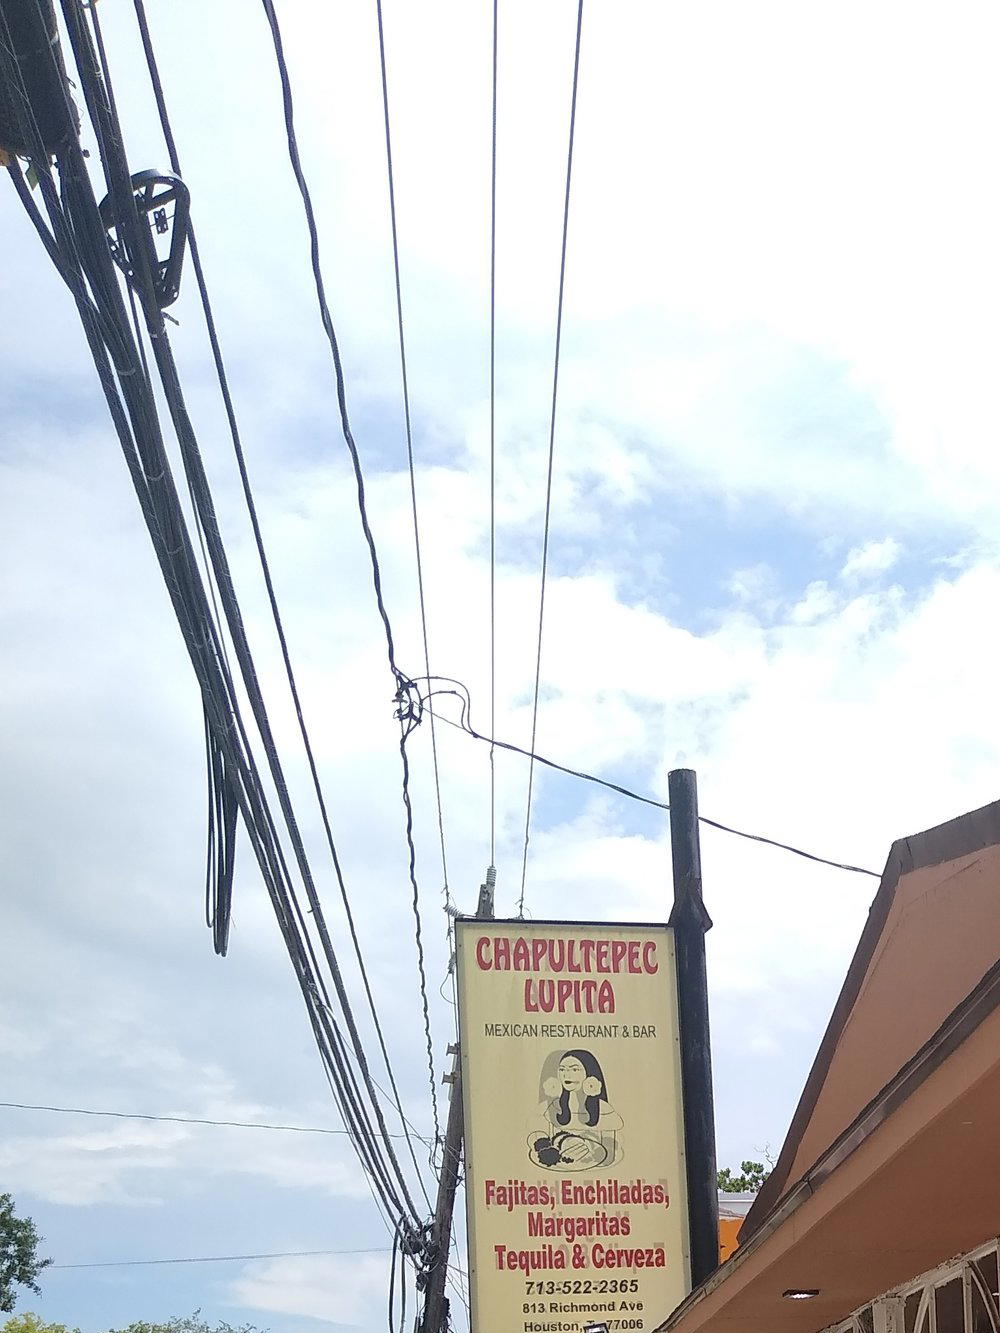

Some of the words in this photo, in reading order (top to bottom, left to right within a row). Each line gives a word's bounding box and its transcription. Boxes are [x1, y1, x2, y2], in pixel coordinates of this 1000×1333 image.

[476, 936, 659, 975] CHAPULTEPEC
[524, 979, 616, 1014] LUPITA
[485, 1023, 538, 1037] MEXICAN
[541, 1024, 618, 1038] RESTAURANT
[622, 1025, 629, 1038] &
[633, 1025, 657, 1038] BAR
[485, 1180, 555, 1211] Fajitas,
[561, 1179, 670, 1209] Enchiladas,
[527, 1211, 631, 1243] Margaritas
[494, 1244, 566, 1276] Tequila
[572, 1244, 585, 1269] &
[591, 1243, 666, 1269] Cerveza
[525, 1279, 639, 1295] 713-522-2365
[522, 1303, 546, 1314] 813
[549, 1301, 616, 1313] Richmond
[619, 1301, 644, 1312] Ave
[524, 1322, 583, 1333] Houston,
[606, 1319, 644, 1330] 77006
